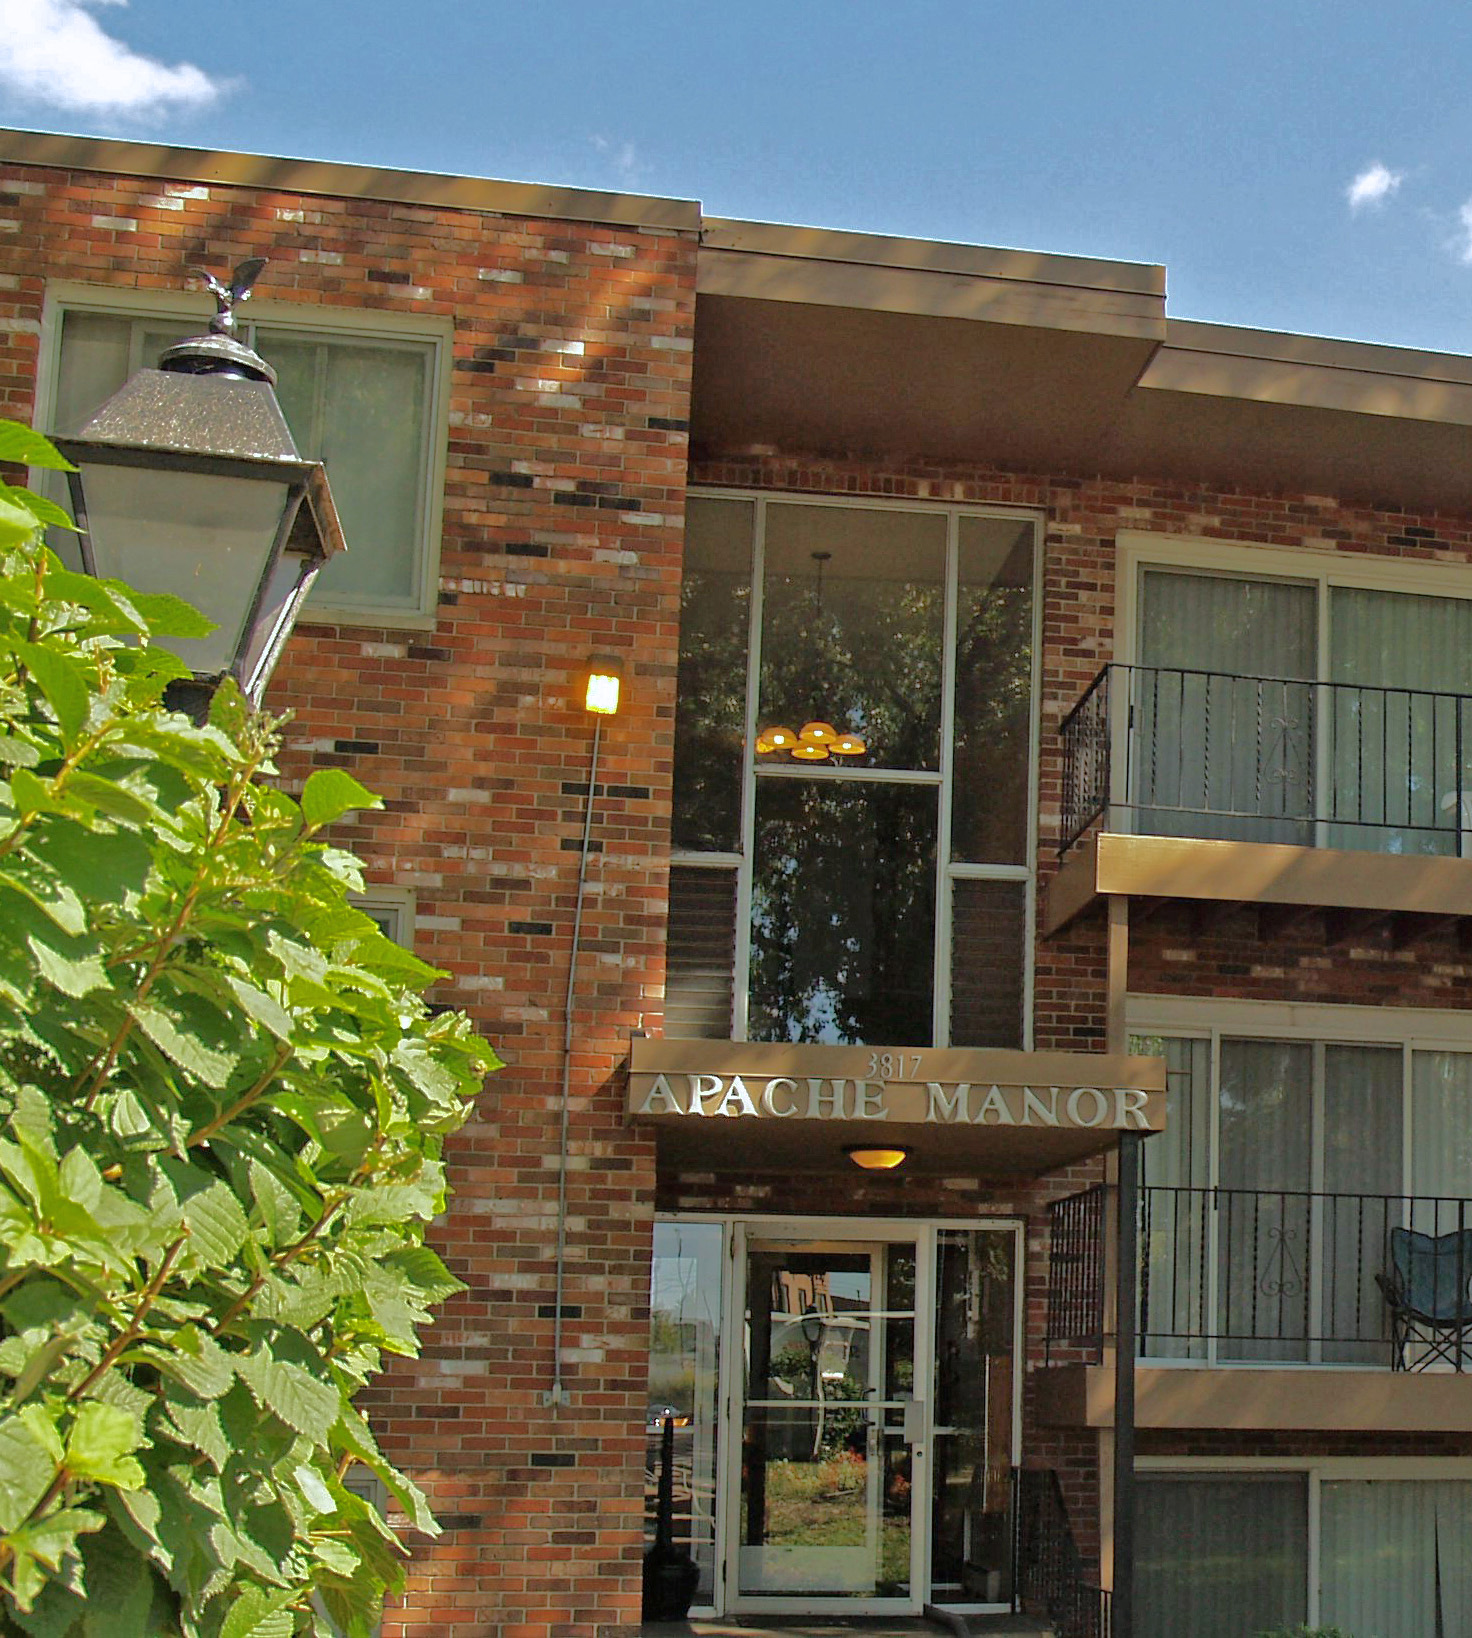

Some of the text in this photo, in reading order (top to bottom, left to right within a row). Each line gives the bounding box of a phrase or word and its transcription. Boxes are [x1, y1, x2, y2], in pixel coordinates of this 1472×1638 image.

[866, 1052, 923, 1080] 3817
[638, 1073, 1152, 1129] APACHE MANOR
